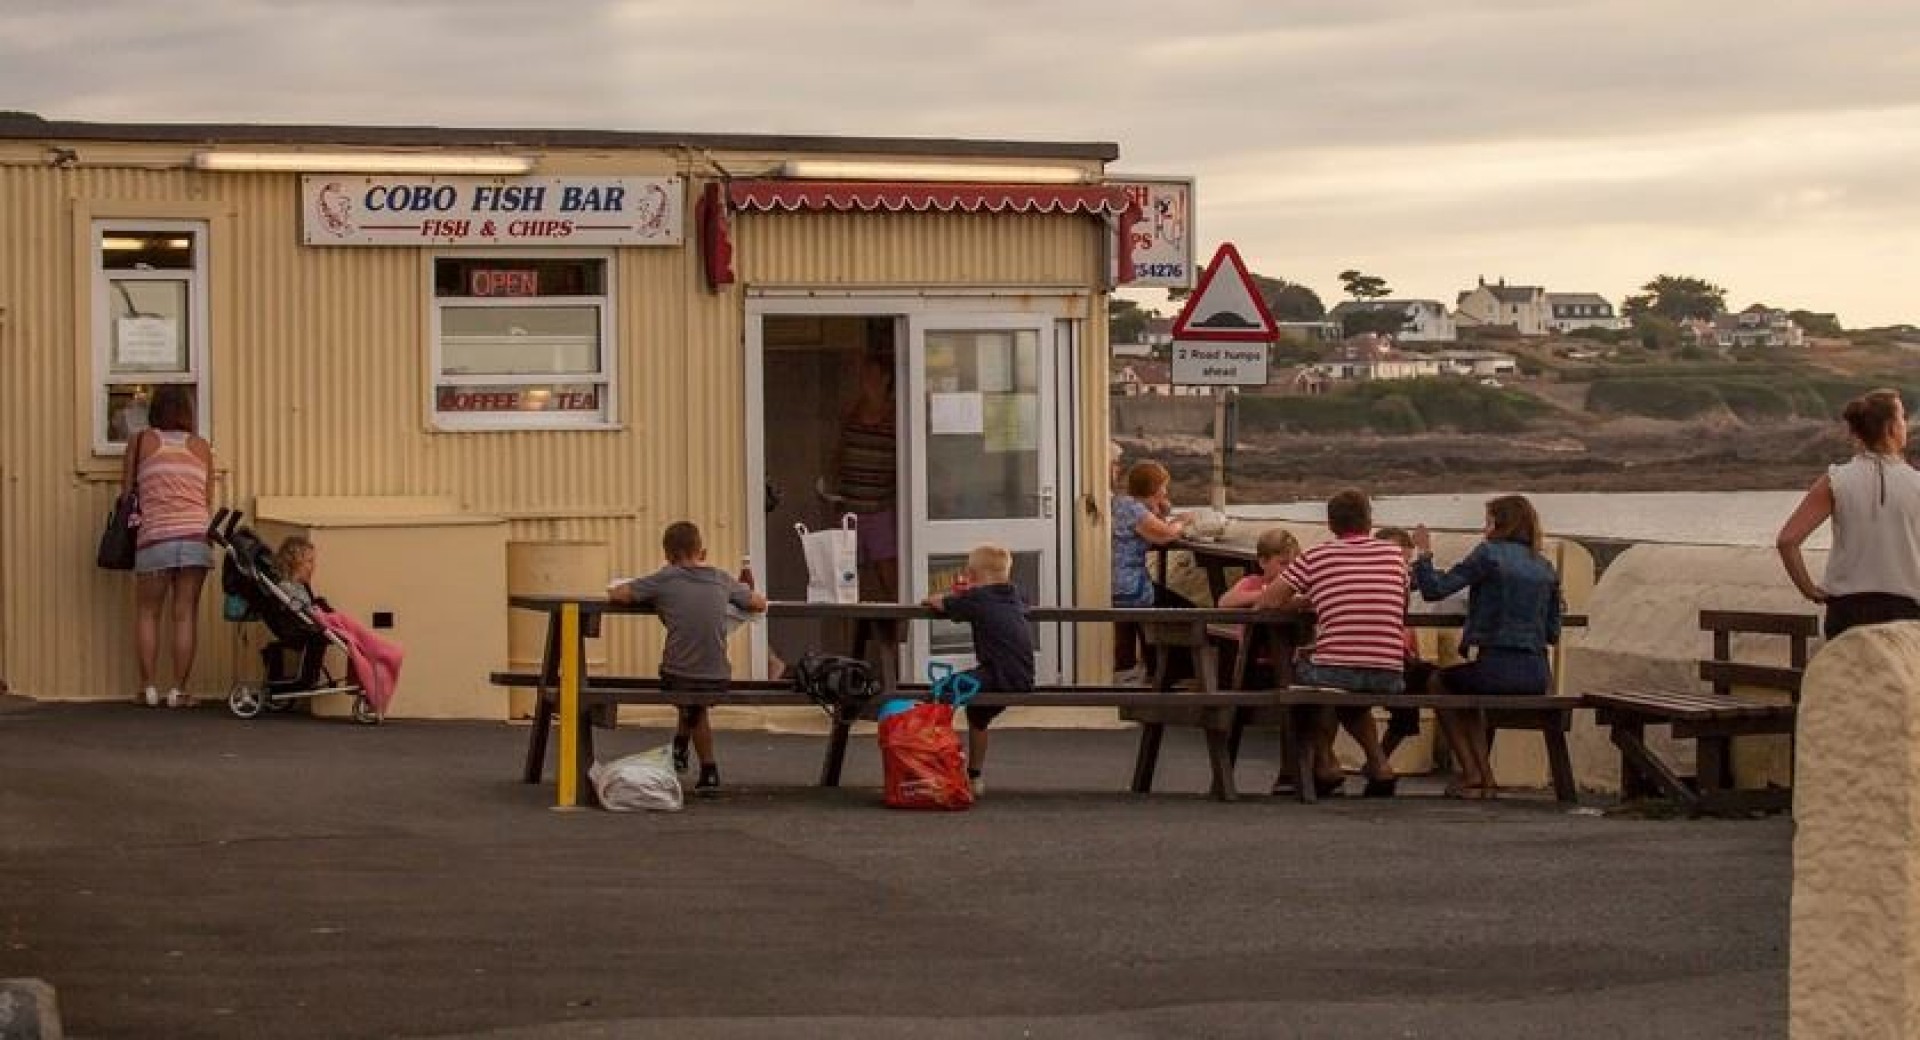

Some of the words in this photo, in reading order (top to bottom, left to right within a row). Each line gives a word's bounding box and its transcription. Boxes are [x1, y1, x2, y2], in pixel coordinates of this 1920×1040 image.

[365, 185, 457, 212] COBO
[471, 186, 546, 212] FISH
[560, 186, 625, 212] BAR
[421, 219, 470, 237] FISH
[480, 219, 497, 237] &
[508, 219, 574, 238] CHIPS
[473, 270, 538, 296] OPEN
[1179, 348, 1187, 359] 2
[1191, 349, 1220, 360] Road
[1225, 349, 1260, 362] humps
[1202, 365, 1238, 377] ahead
[440, 393, 520, 410] COFFEE
[557, 392, 597, 410] TEA
